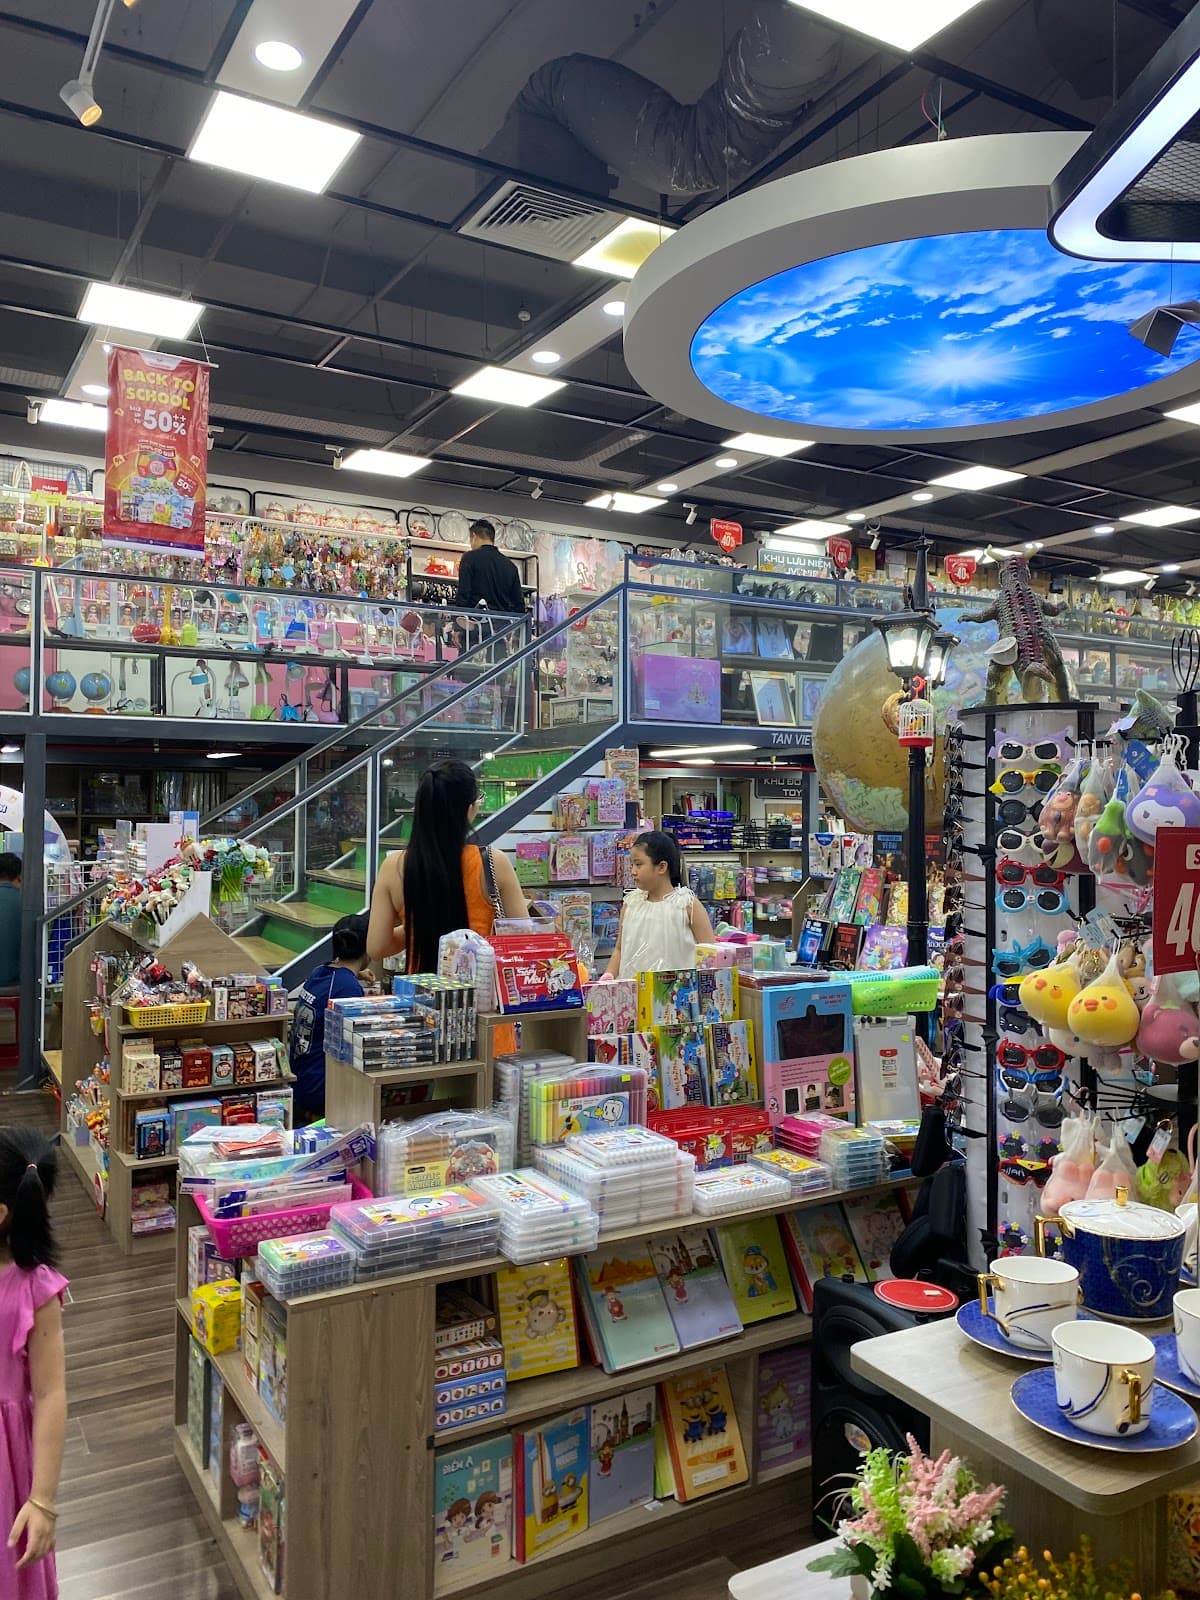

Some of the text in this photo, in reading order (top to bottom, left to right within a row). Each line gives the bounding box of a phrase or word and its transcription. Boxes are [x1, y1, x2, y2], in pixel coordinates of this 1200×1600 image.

[123, 368, 195, 393] BACK TO
[126, 387, 191, 411] SCHOOL
[763, 554, 785, 563] KHU
[771, 732, 812, 746] TAN VIE
